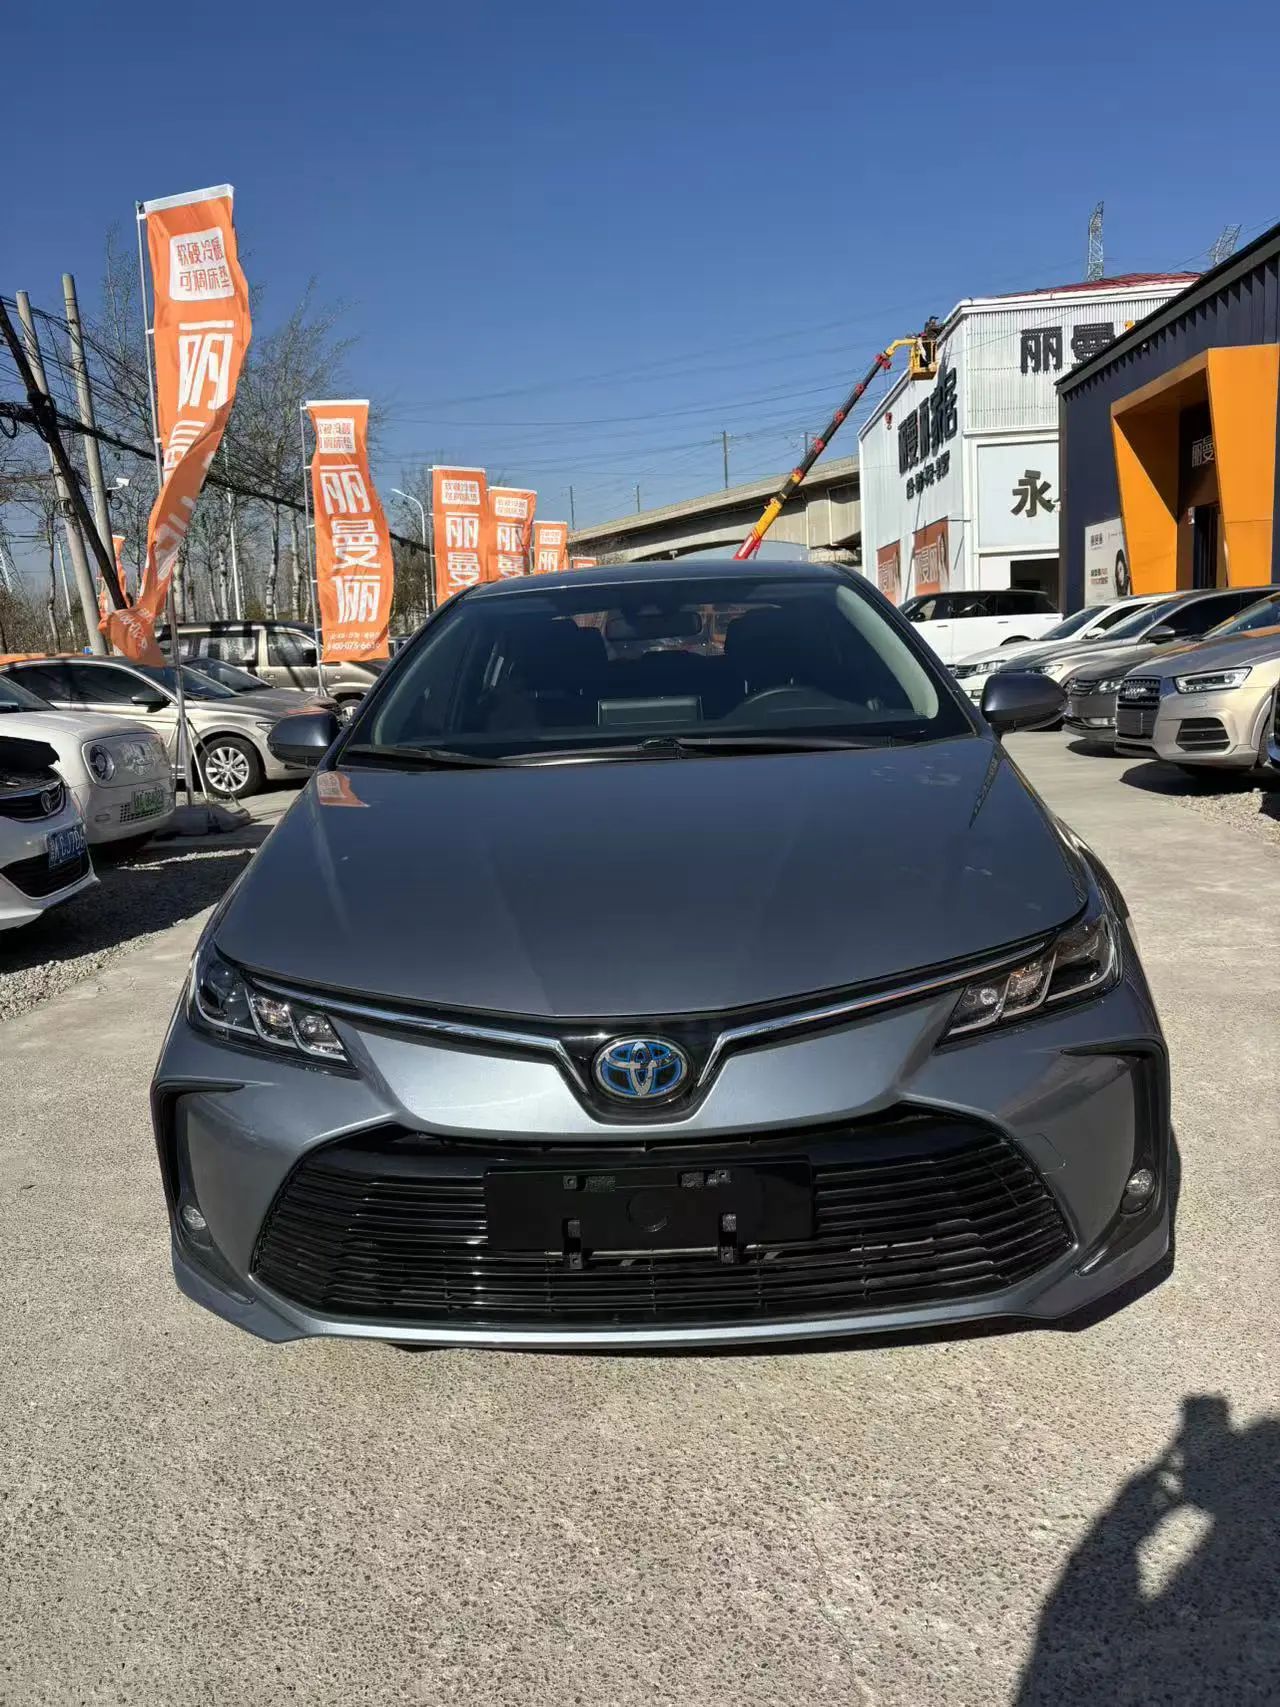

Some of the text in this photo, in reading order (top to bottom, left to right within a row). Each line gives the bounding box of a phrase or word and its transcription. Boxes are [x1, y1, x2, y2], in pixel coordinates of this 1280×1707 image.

[179, 265, 231, 292] 可调床垫
[1010, 469, 1056, 518] 永
[445, 512, 480, 598] 丽曼
